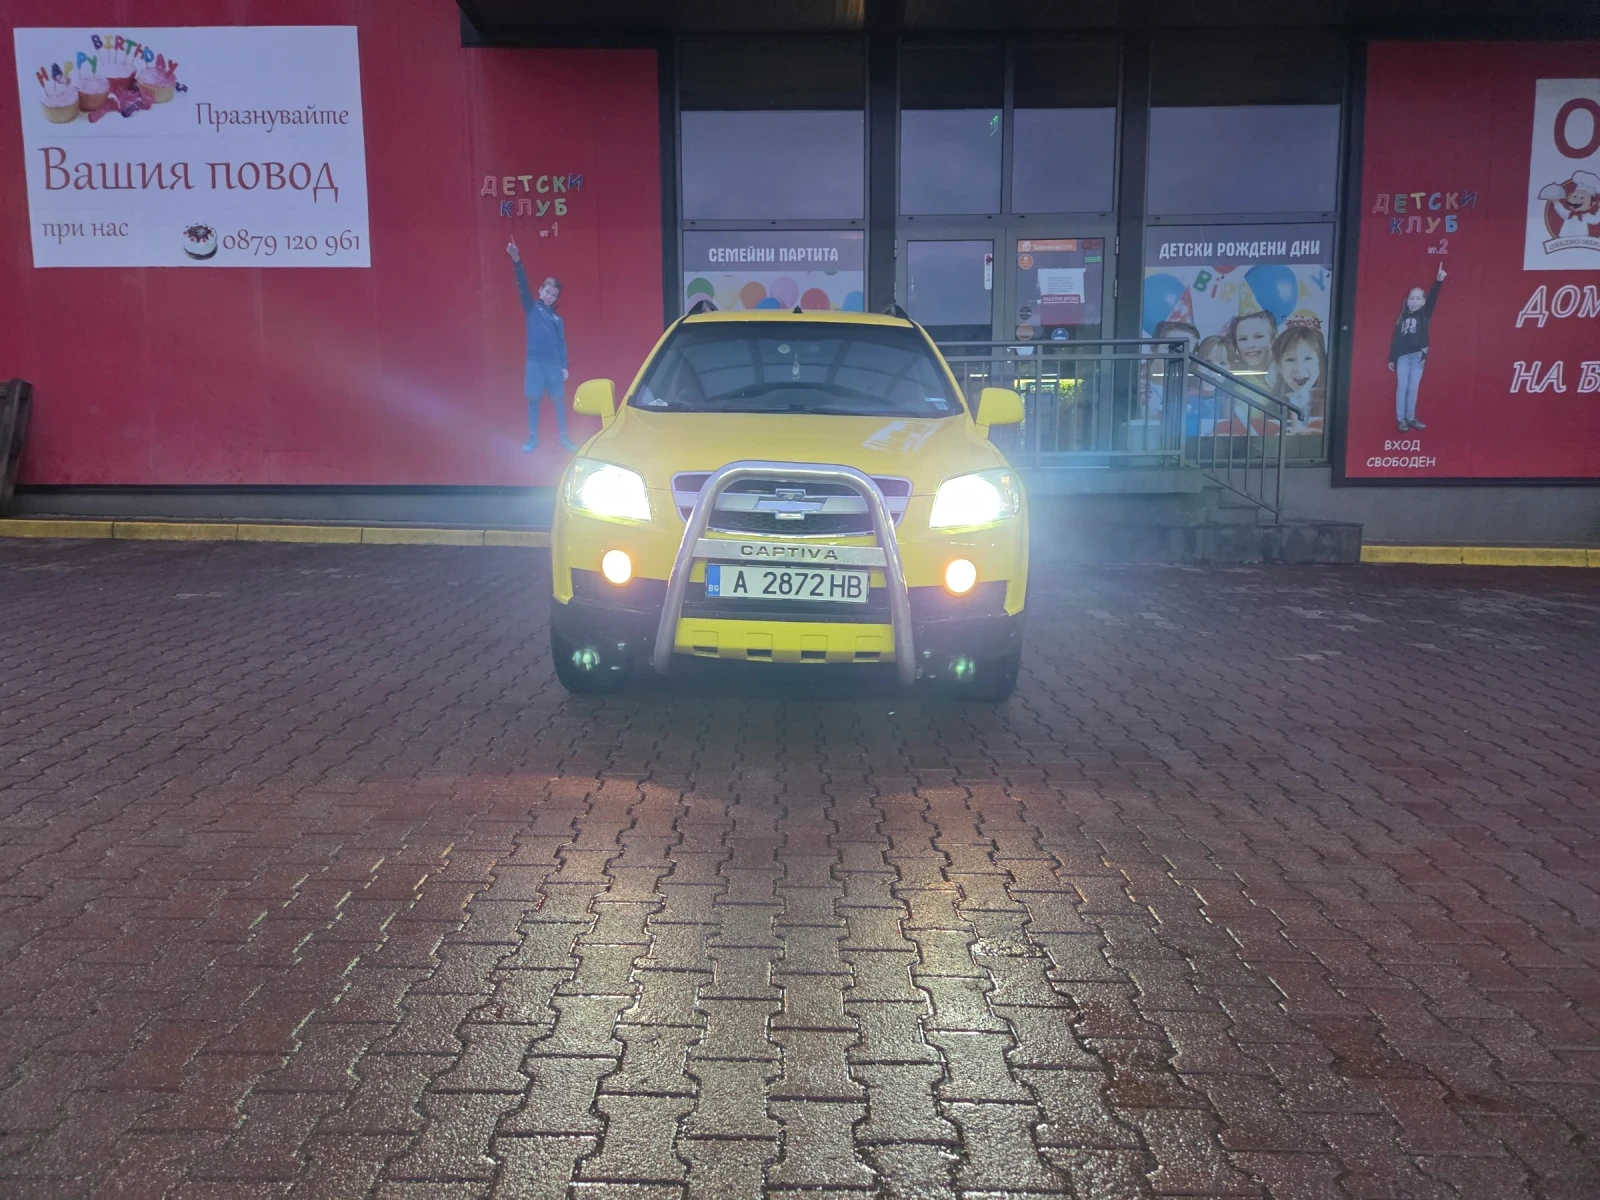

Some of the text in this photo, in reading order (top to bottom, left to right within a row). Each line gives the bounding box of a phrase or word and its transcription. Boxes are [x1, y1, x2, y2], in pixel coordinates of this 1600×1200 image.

[91, 34, 179, 77] BIRTHDAY
[36, 51, 98, 87] HAPPY
[195, 103, 349, 133] Празнувайте
[38, 147, 339, 203] Вашия повод
[480, 172, 583, 197] ДЕТСКИ
[500, 197, 568, 217] КЛУБ
[1371, 189, 1478, 215] ДЕТСКИ
[42, 221, 129, 244] при нас
[1390, 214, 1459, 235] КЛУБ
[222, 229, 361, 256] 0879 120 961
[708, 246, 839, 262] СЕМЕЙНИ ПАРТИТА
[1159, 240, 1320, 259] ДЕТСКИ РОЖДЕНИ ДНИ
[1582, 239, 1600, 248] МЕН
[1510, 360, 1600, 393] НА Б
[1384, 440, 1421, 451] ВХОД
[1366, 456, 1436, 468] СВОБОДЕН
[740, 545, 838, 560] CAPTIVA
